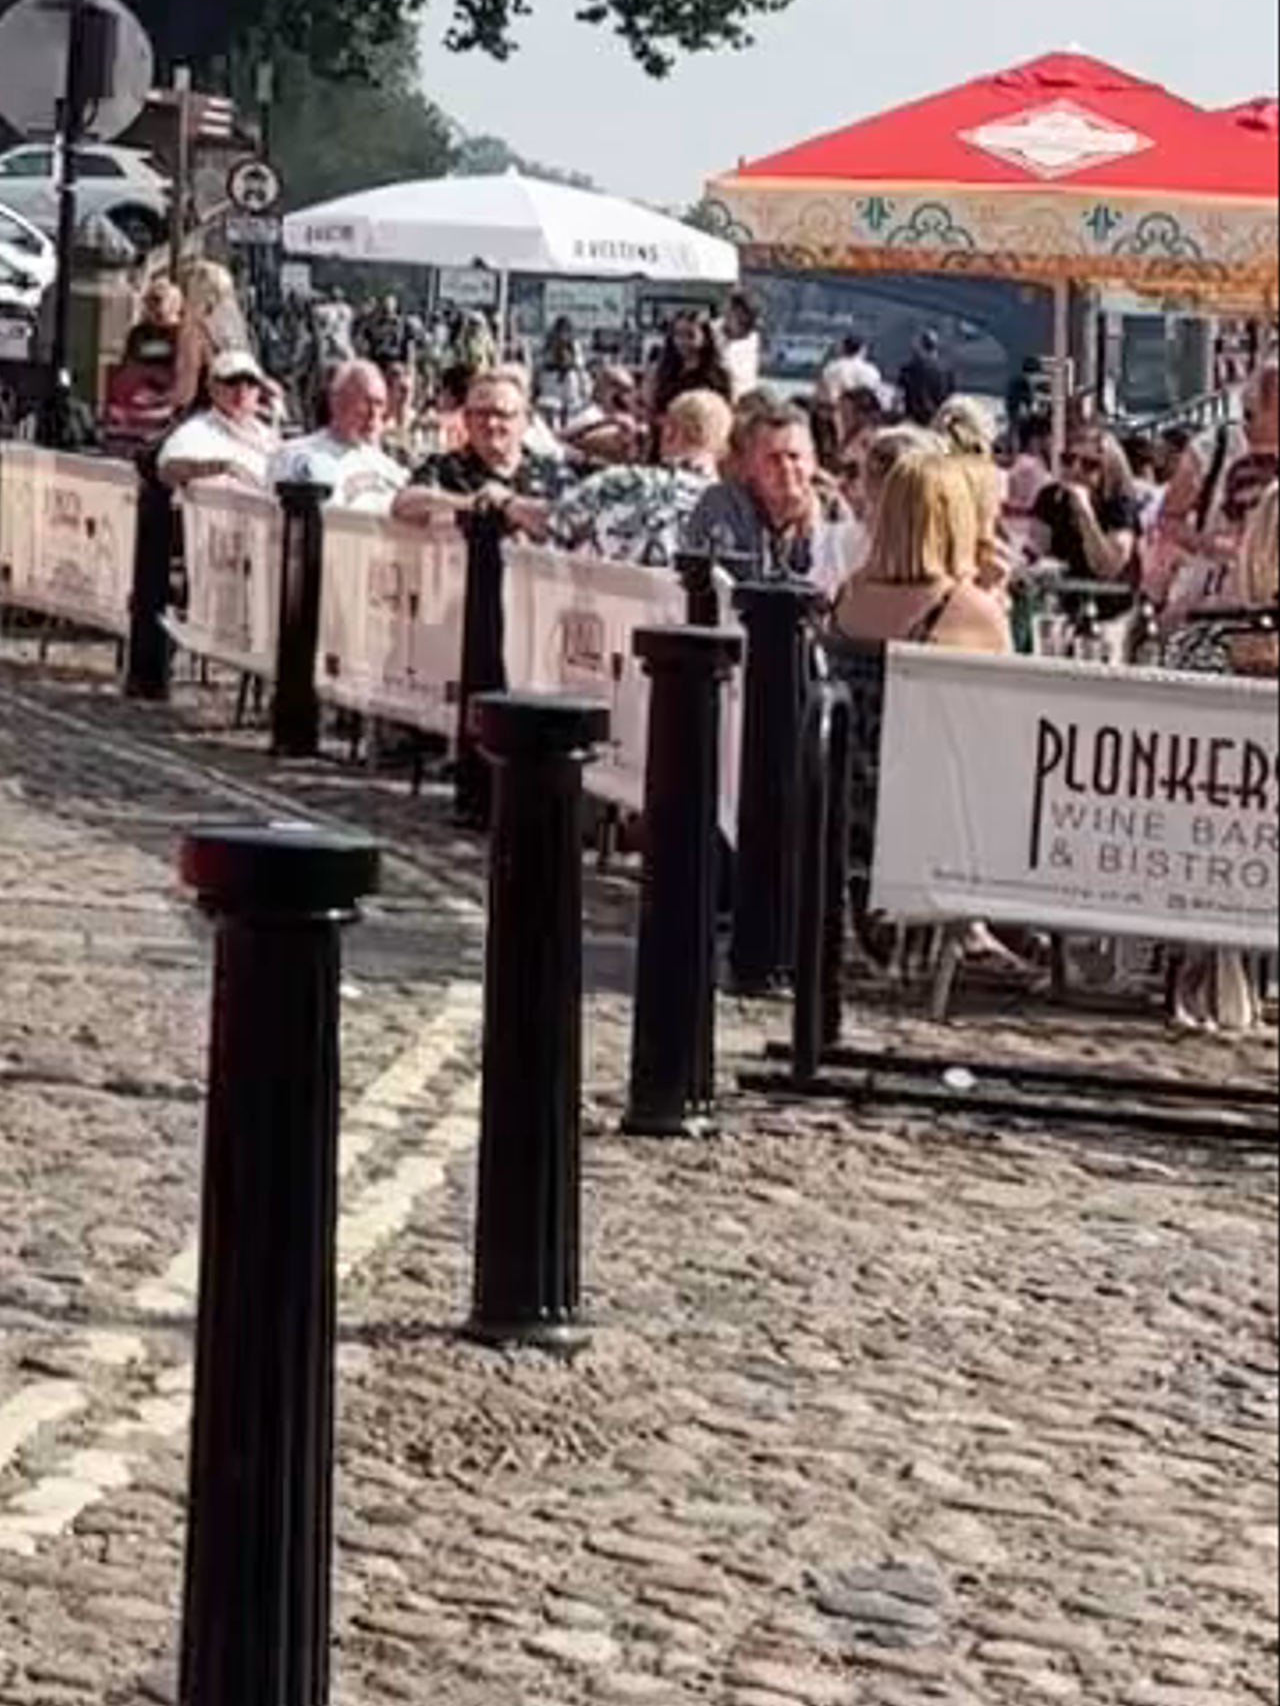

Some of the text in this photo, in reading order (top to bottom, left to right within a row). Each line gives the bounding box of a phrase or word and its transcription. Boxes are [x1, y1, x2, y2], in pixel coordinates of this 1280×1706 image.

[1029, 716, 1278, 869] PLONKER
[1050, 800, 1278, 852] WINE BAR
[1049, 837, 1072, 869] &
[1098, 842, 1271, 889] BISTRO
